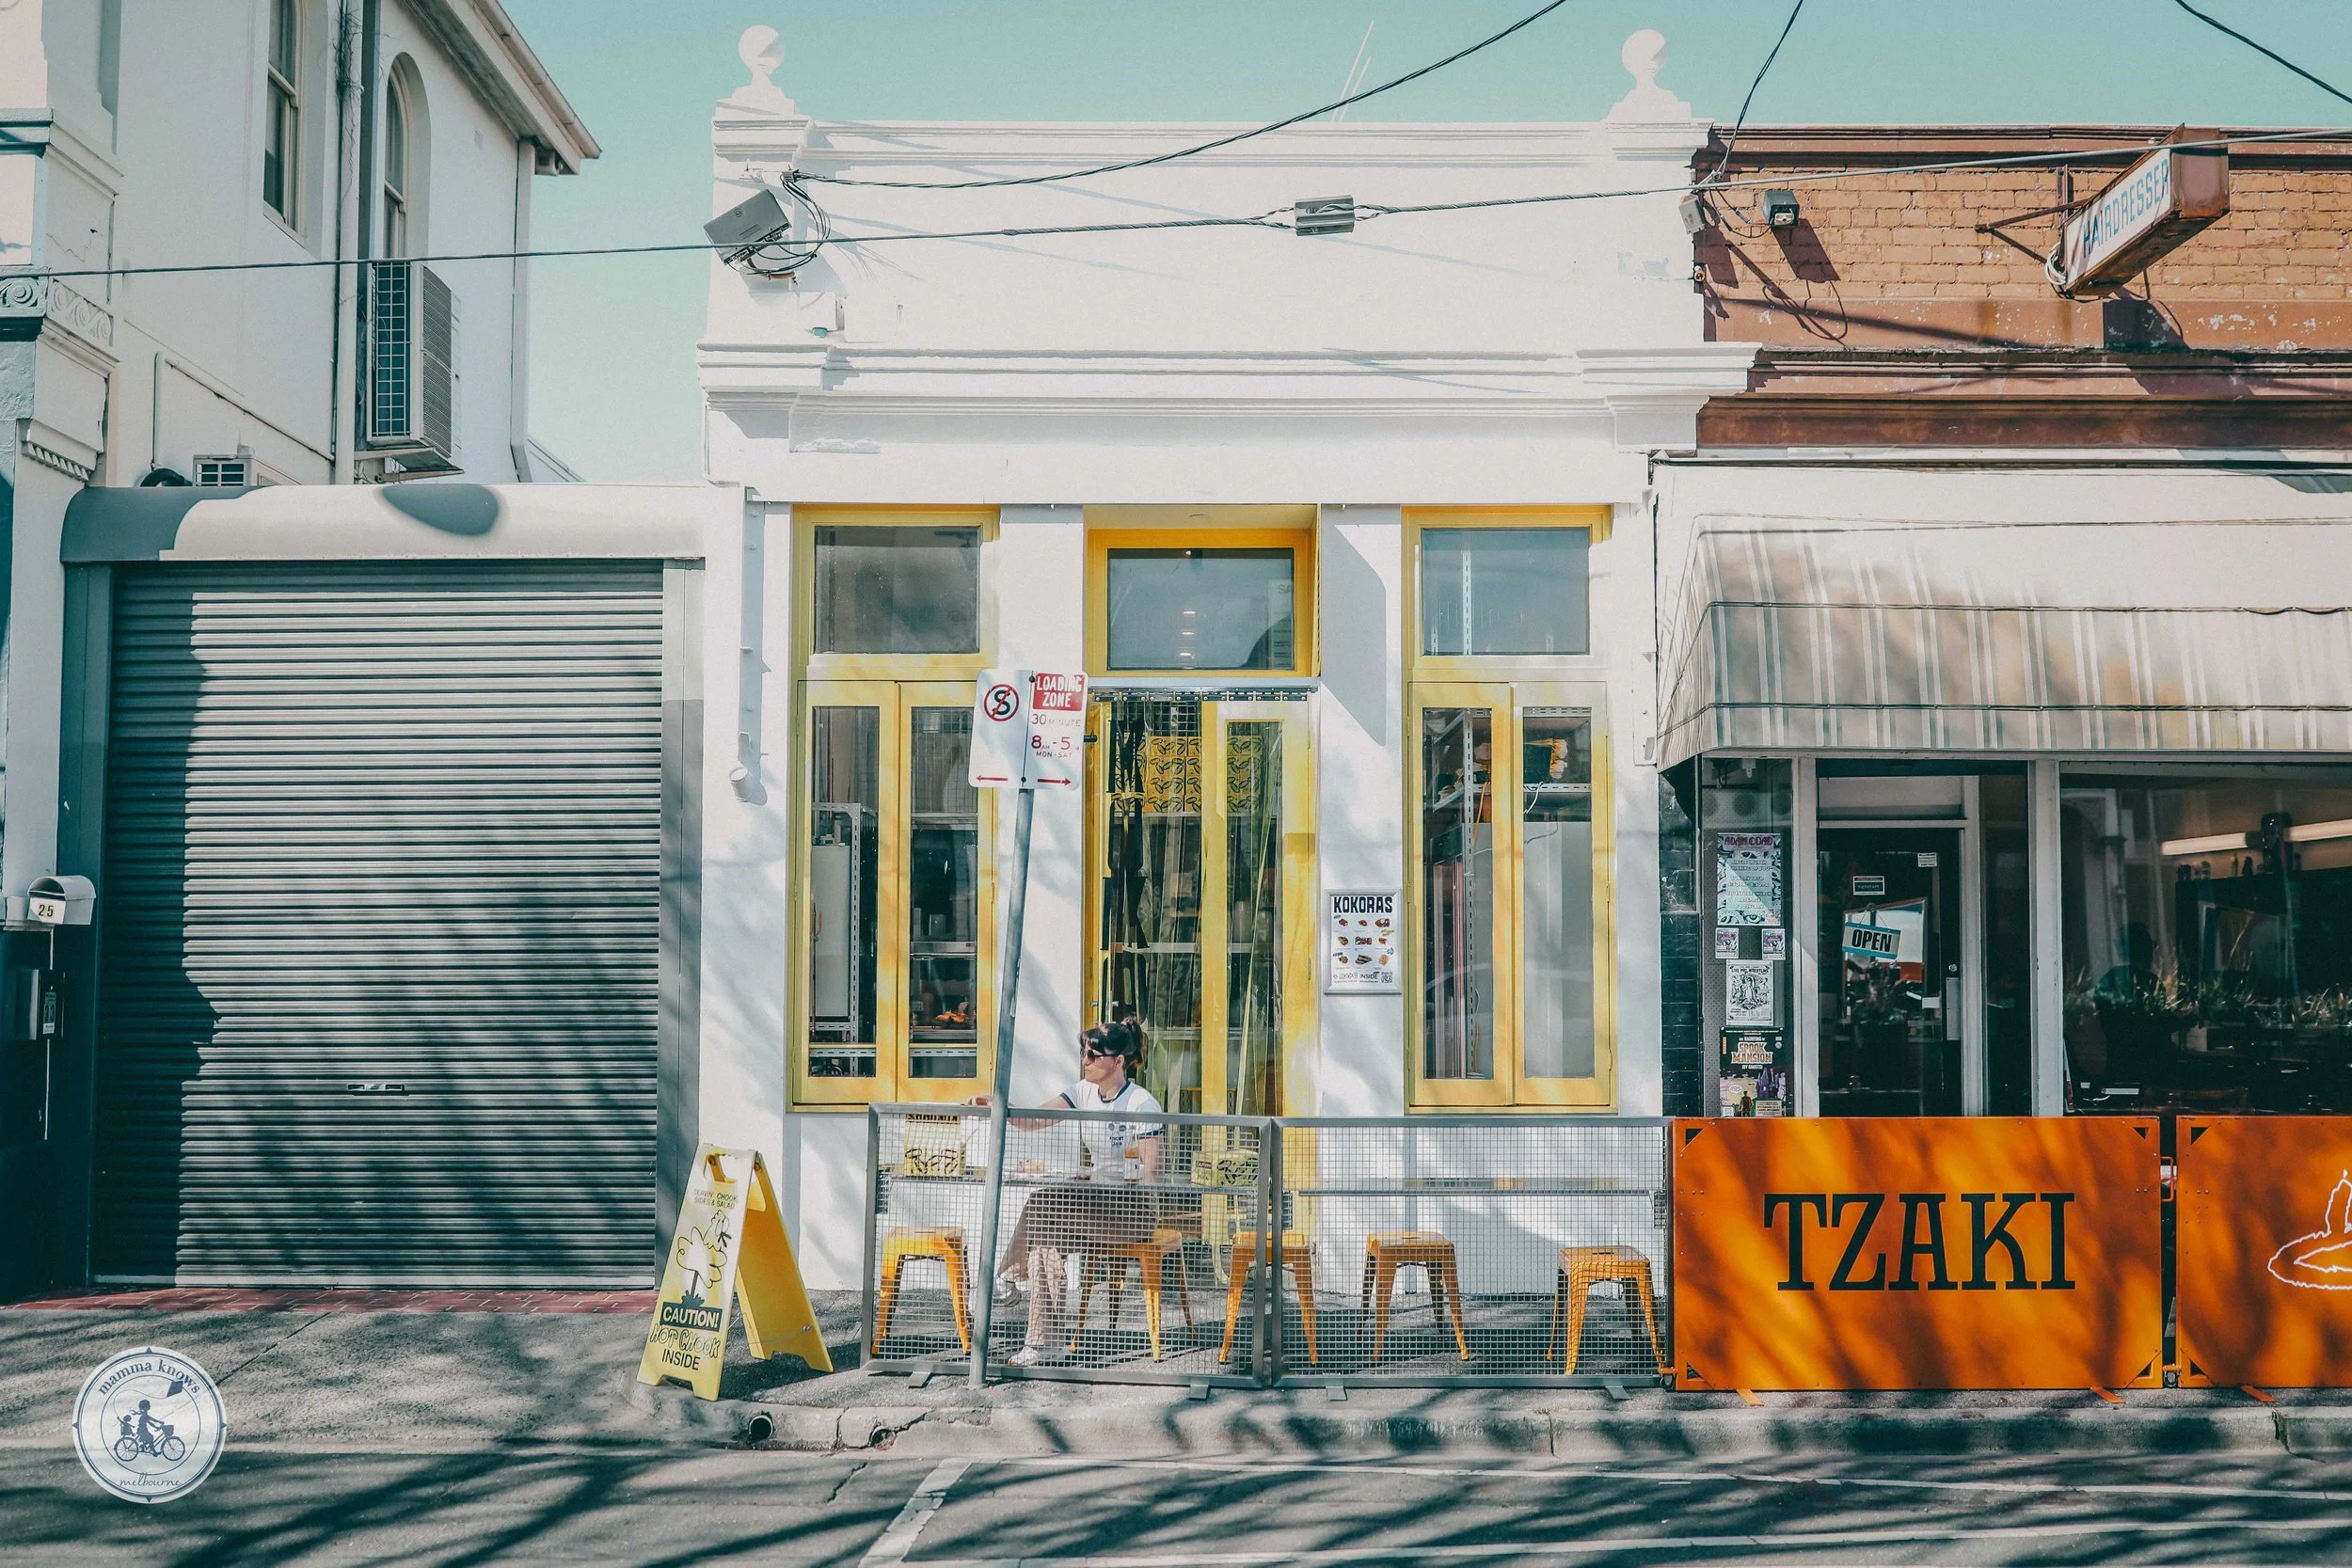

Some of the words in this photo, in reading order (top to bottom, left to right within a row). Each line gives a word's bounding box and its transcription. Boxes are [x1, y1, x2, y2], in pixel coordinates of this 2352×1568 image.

[2082, 158, 2169, 260] HAIRDRESSER
[1037, 675, 1083, 692] LOADING
[1041, 691, 1072, 707] ZONE
[1031, 713, 1047, 725] 30
[39, 904, 54, 917] 25
[1333, 896, 1393, 913] KOKORAS
[1851, 928, 1893, 953] OPEN
[1739, 1043, 1765, 1053] SPOOK
[1732, 1053, 1772, 1063] MANSION
[1763, 1192, 2076, 1292] TZAKI
[662, 1306, 720, 1328] CAUTION!
[650, 1323, 679, 1349] HOT
[678, 1329, 721, 1359] CHOOK
[661, 1348, 701, 1371] INSIDE
